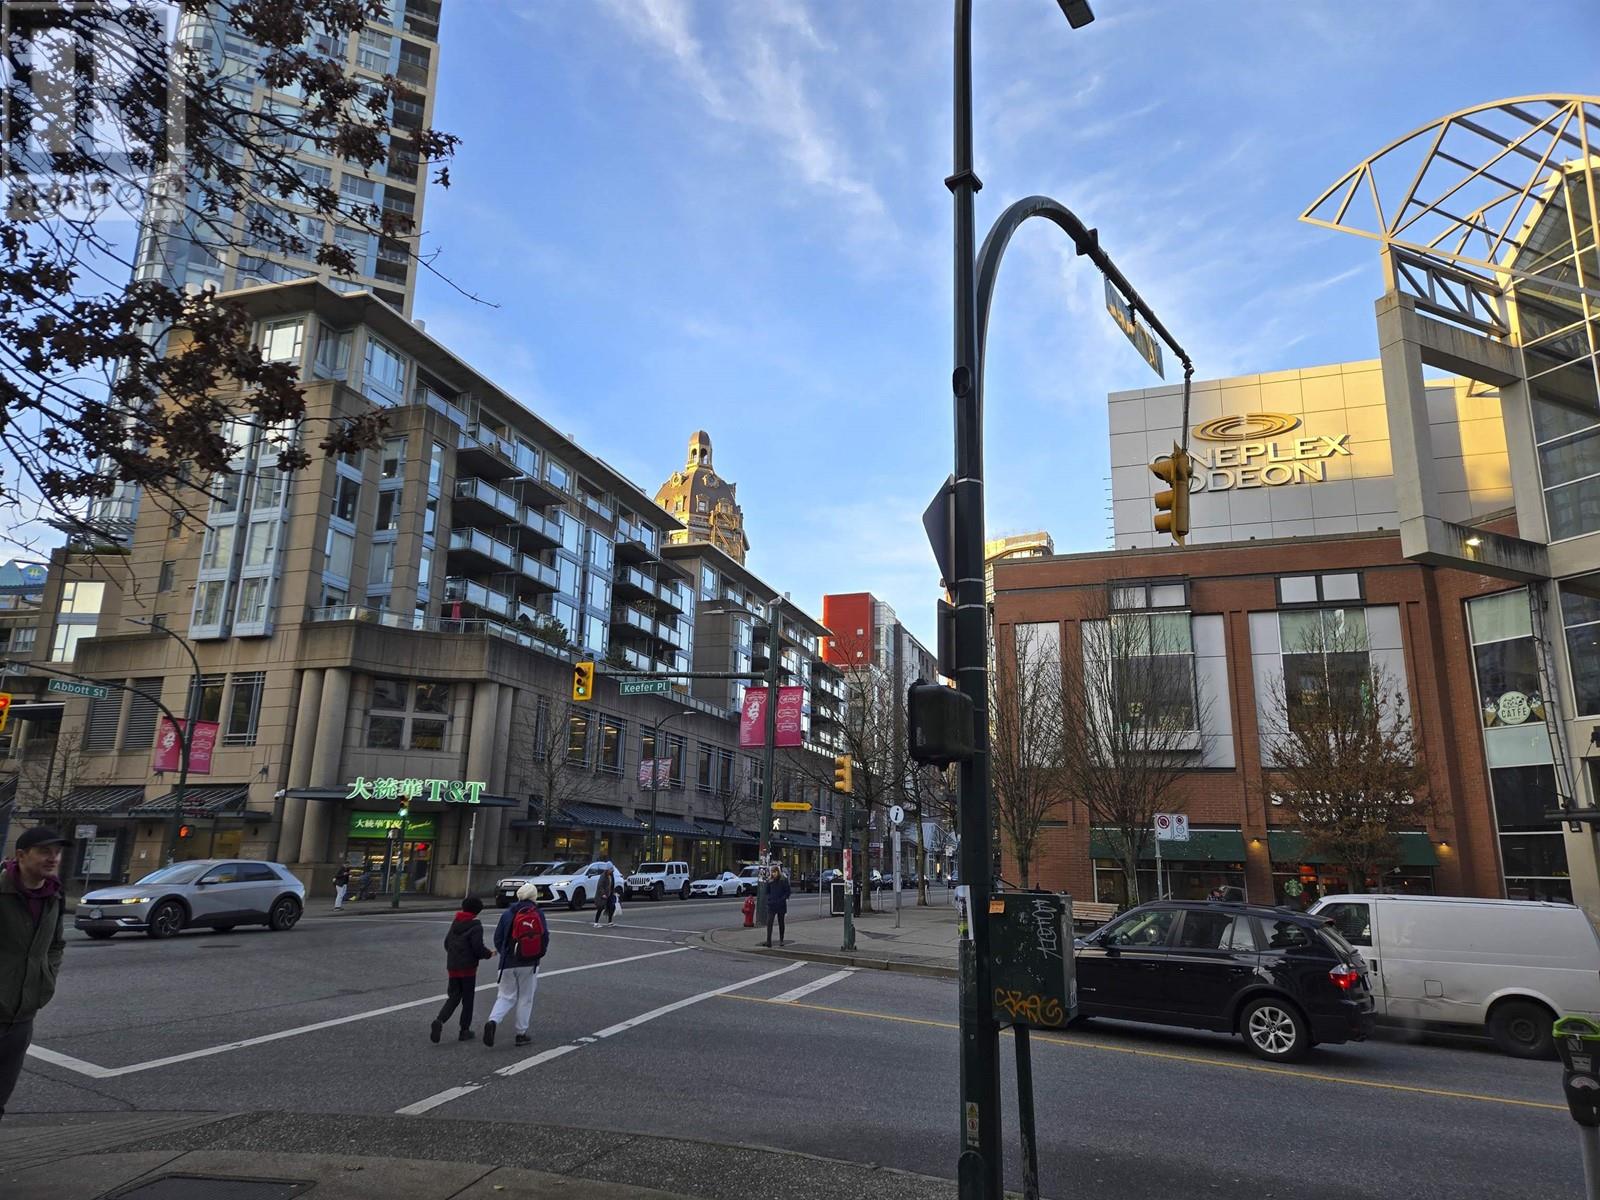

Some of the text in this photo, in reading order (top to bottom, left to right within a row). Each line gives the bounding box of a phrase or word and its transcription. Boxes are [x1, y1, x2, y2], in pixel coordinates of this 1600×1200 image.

[53, 681, 104, 697] Abbott St
[624, 682, 666, 693] Keefer Pl
